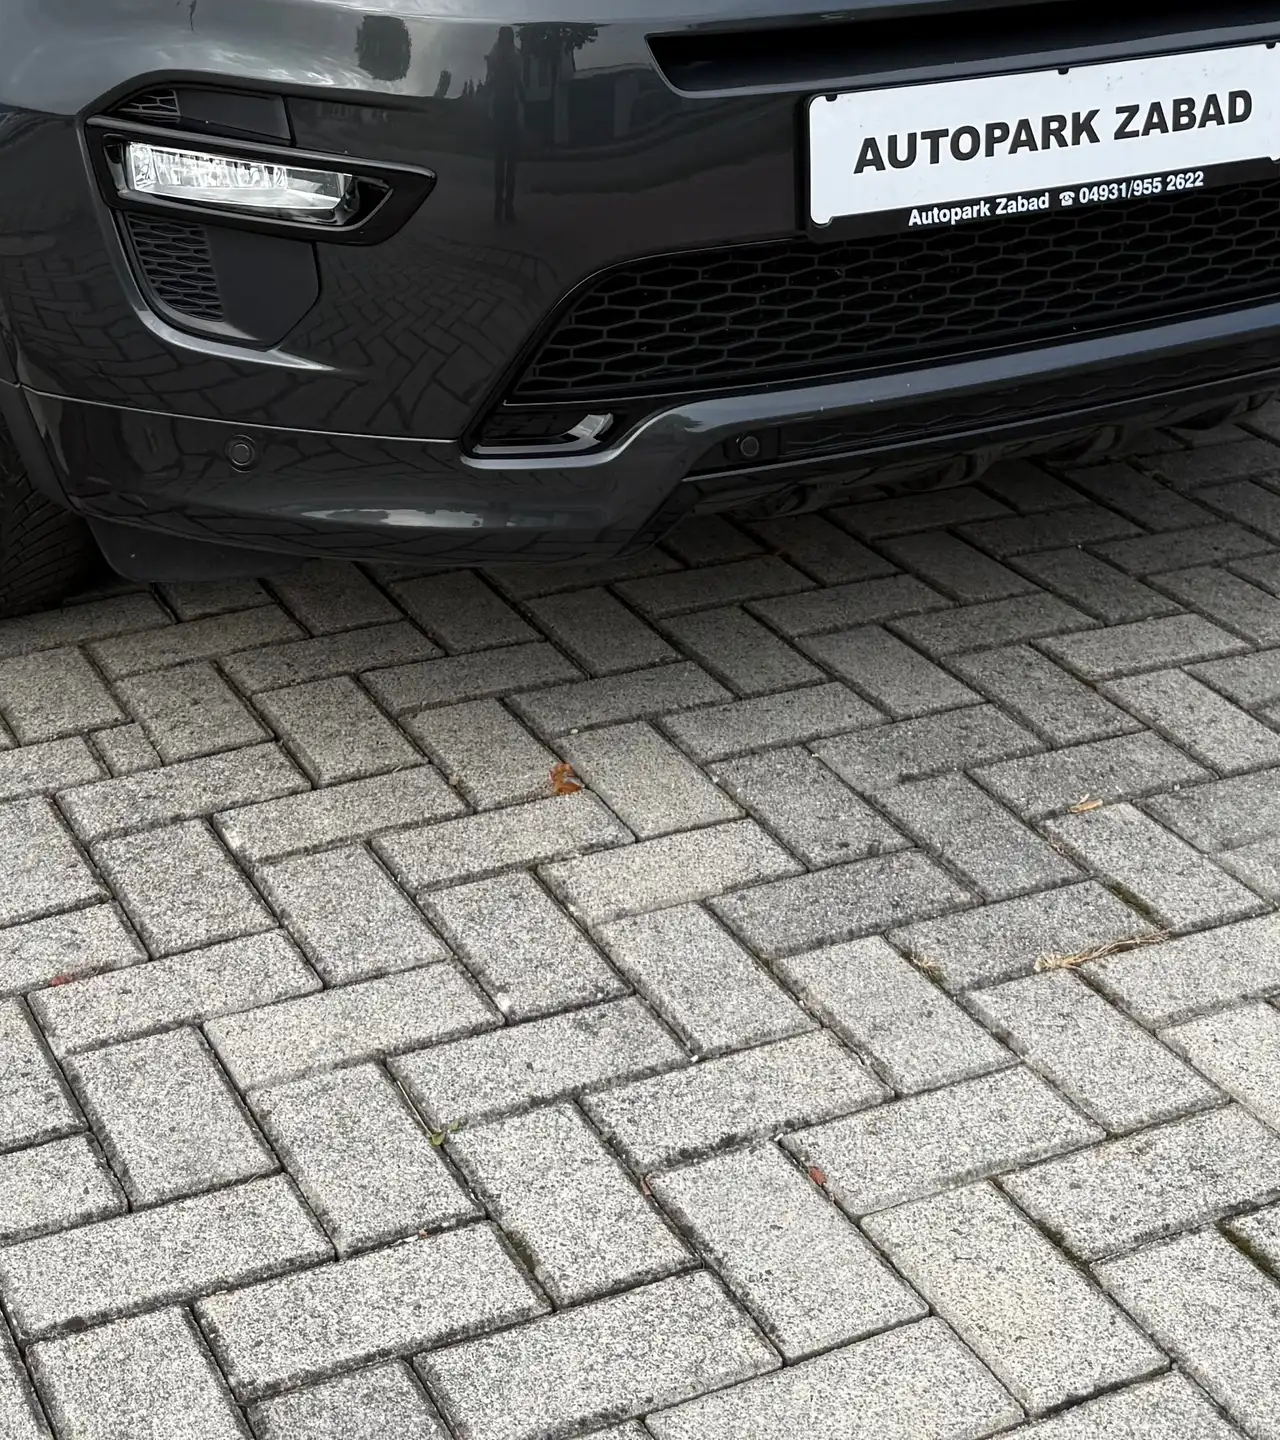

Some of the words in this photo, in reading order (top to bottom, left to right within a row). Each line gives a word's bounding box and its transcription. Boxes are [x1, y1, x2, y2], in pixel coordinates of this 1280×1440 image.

[853, 109, 1100, 174] AUTOPARK
[1113, 89, 1253, 141] ZABAD
[908, 200, 991, 227] Autopark
[996, 193, 1049, 216] Zabad
[1079, 176, 1163, 204] 04931/955
[1166, 172, 1204, 192] 2622
